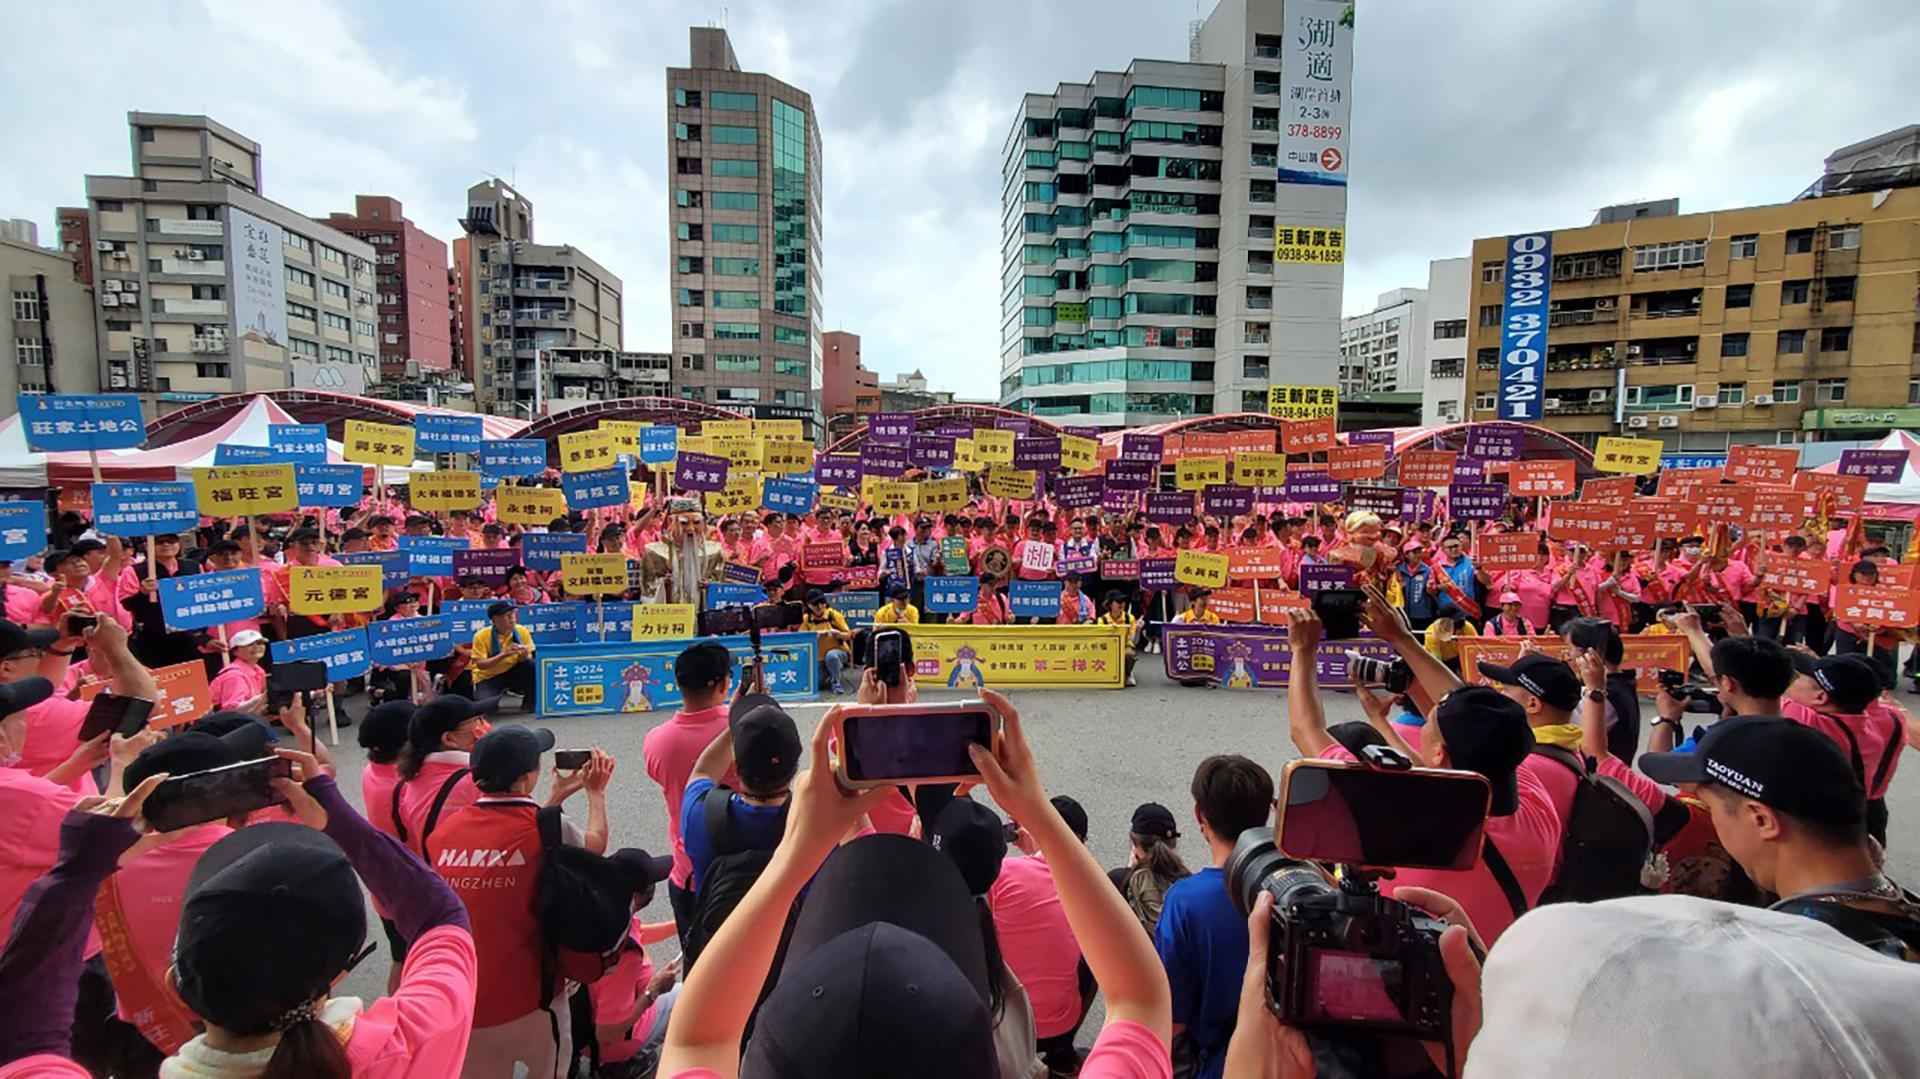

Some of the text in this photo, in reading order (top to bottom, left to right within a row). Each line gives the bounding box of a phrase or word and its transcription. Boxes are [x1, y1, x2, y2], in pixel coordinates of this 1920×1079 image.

[1504, 235, 1547, 418] 0932 370421
[31, 419, 138, 435] 莊家土地公
[212, 486, 283, 502] 福旺宮
[305, 586, 370, 603] 元德宮
[1191, 637, 1216, 647] 2024
[574, 664, 604, 674] 2024
[1034, 658, 1107, 674] 第二梯次
[554, 665, 571, 706] 土地公
[1707, 757, 1764, 793] TAOYUAN
[437, 848, 526, 868] HAKKA
